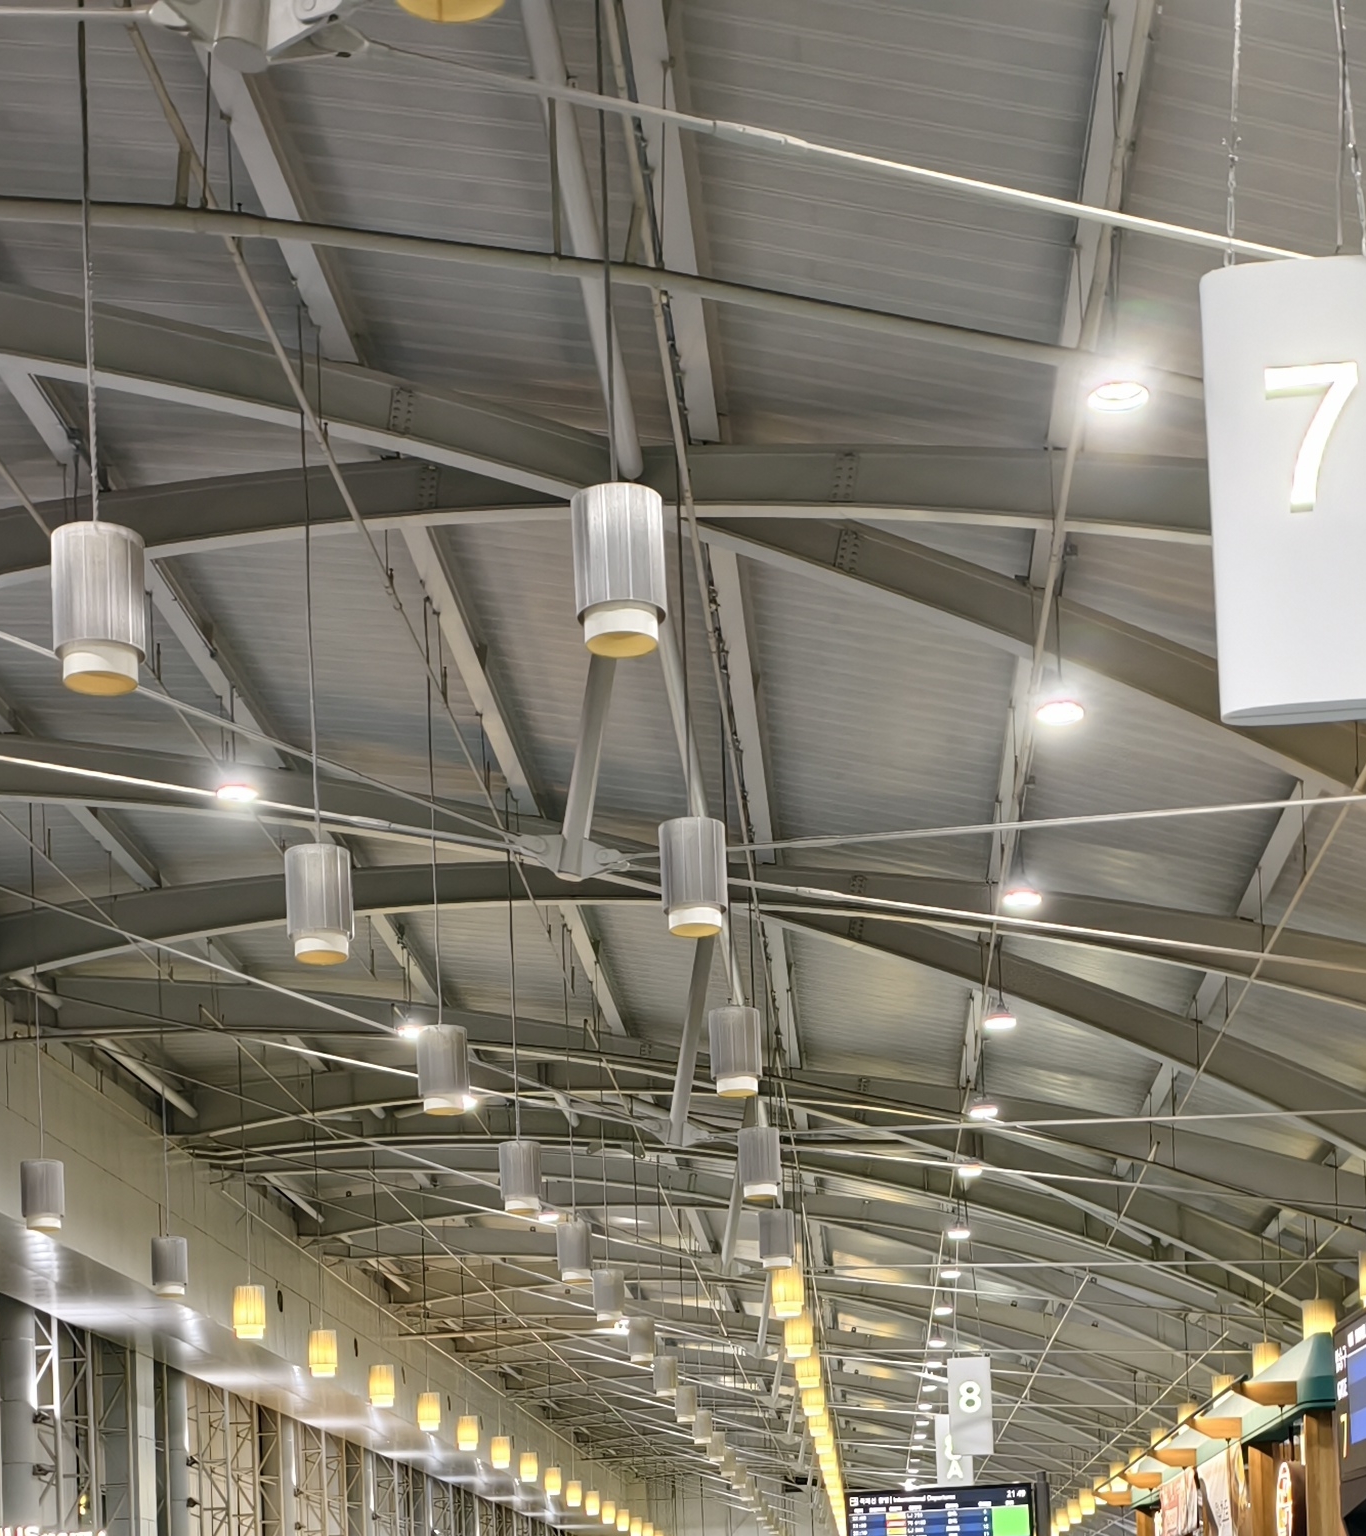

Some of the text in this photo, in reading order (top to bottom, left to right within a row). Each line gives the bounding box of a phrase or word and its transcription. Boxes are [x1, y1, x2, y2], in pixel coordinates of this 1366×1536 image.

[1264, 361, 1358, 513] 7
[959, 1381, 982, 1413] 8
[1340, 1413, 1348, 1459] 7
